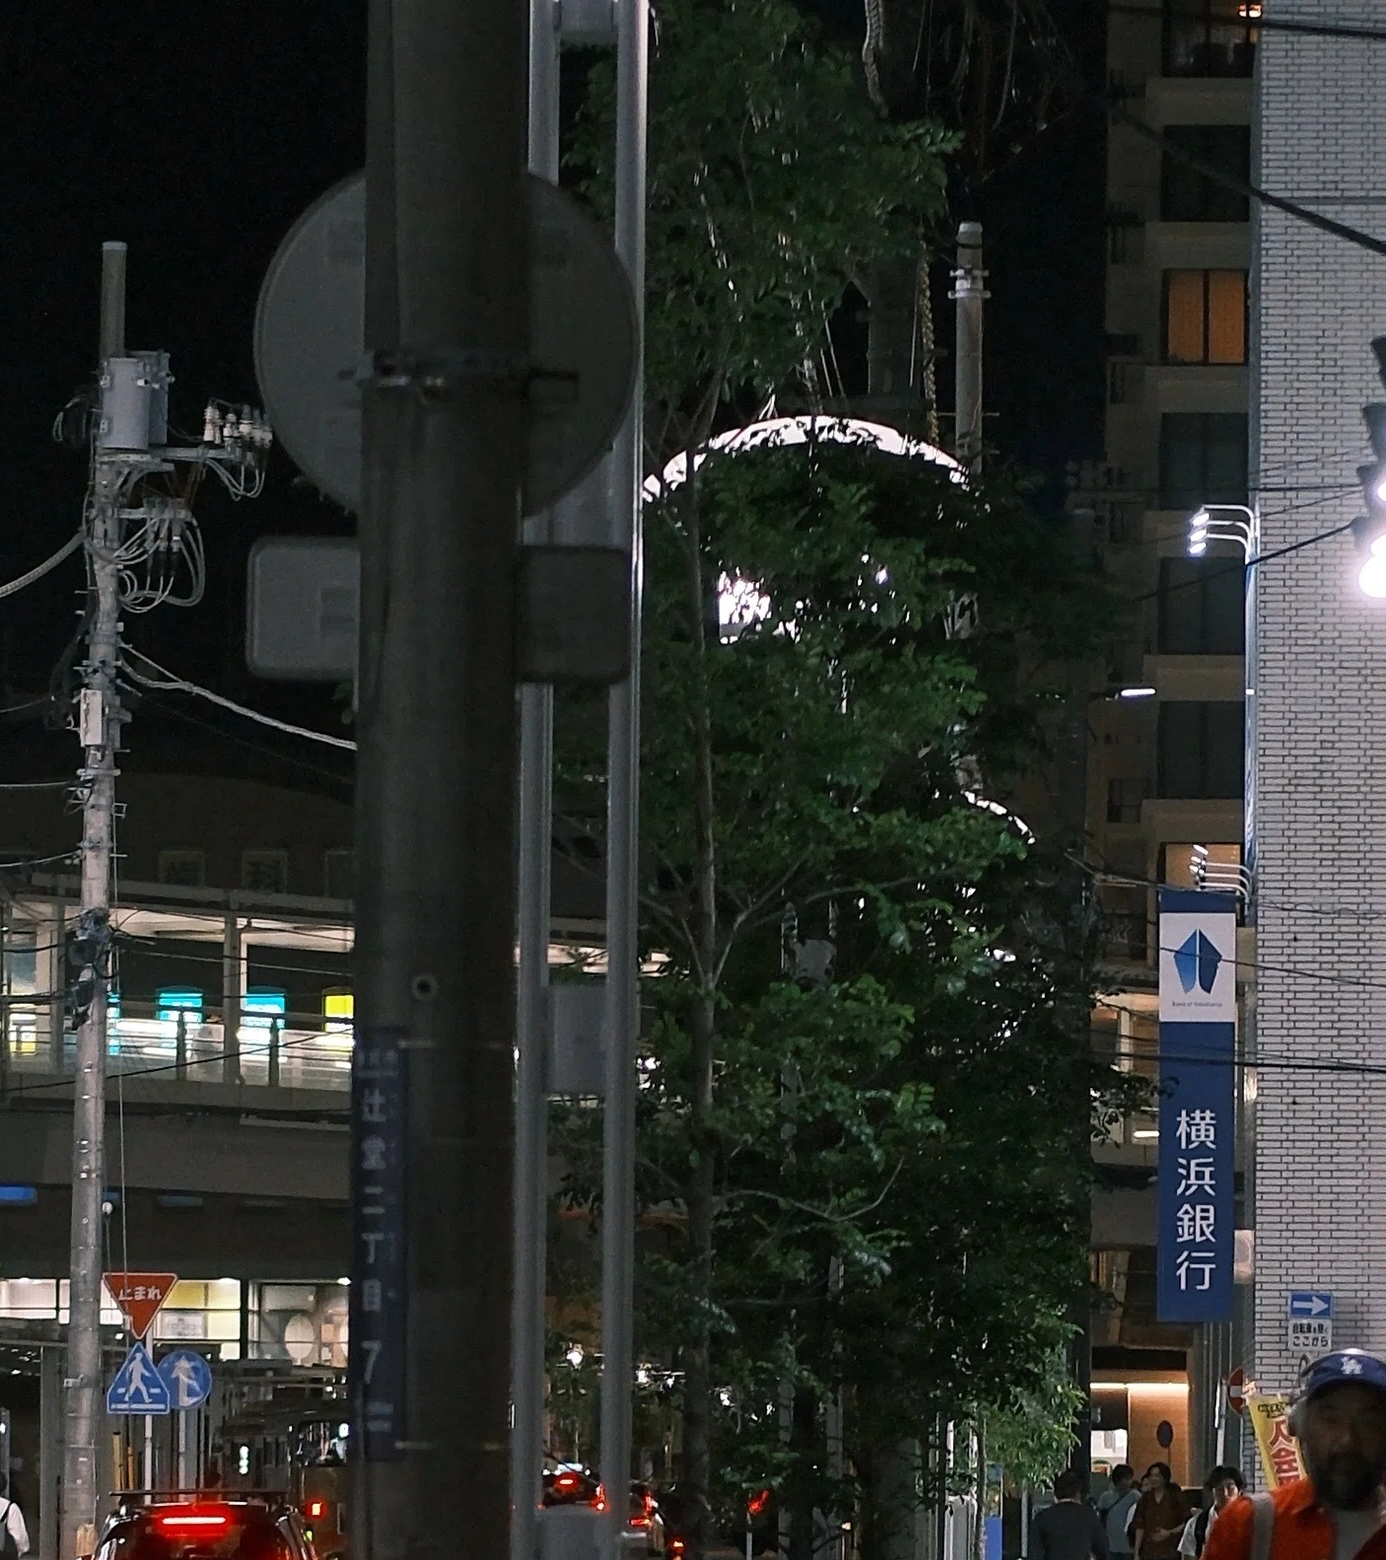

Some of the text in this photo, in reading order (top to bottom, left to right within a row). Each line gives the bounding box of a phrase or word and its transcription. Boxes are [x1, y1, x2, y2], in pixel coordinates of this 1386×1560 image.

[1175, 1109, 1217, 1291] 横浜銀行
[118, 1285, 162, 1302] 止まれ
[1292, 1335, 1329, 1347] ここから
